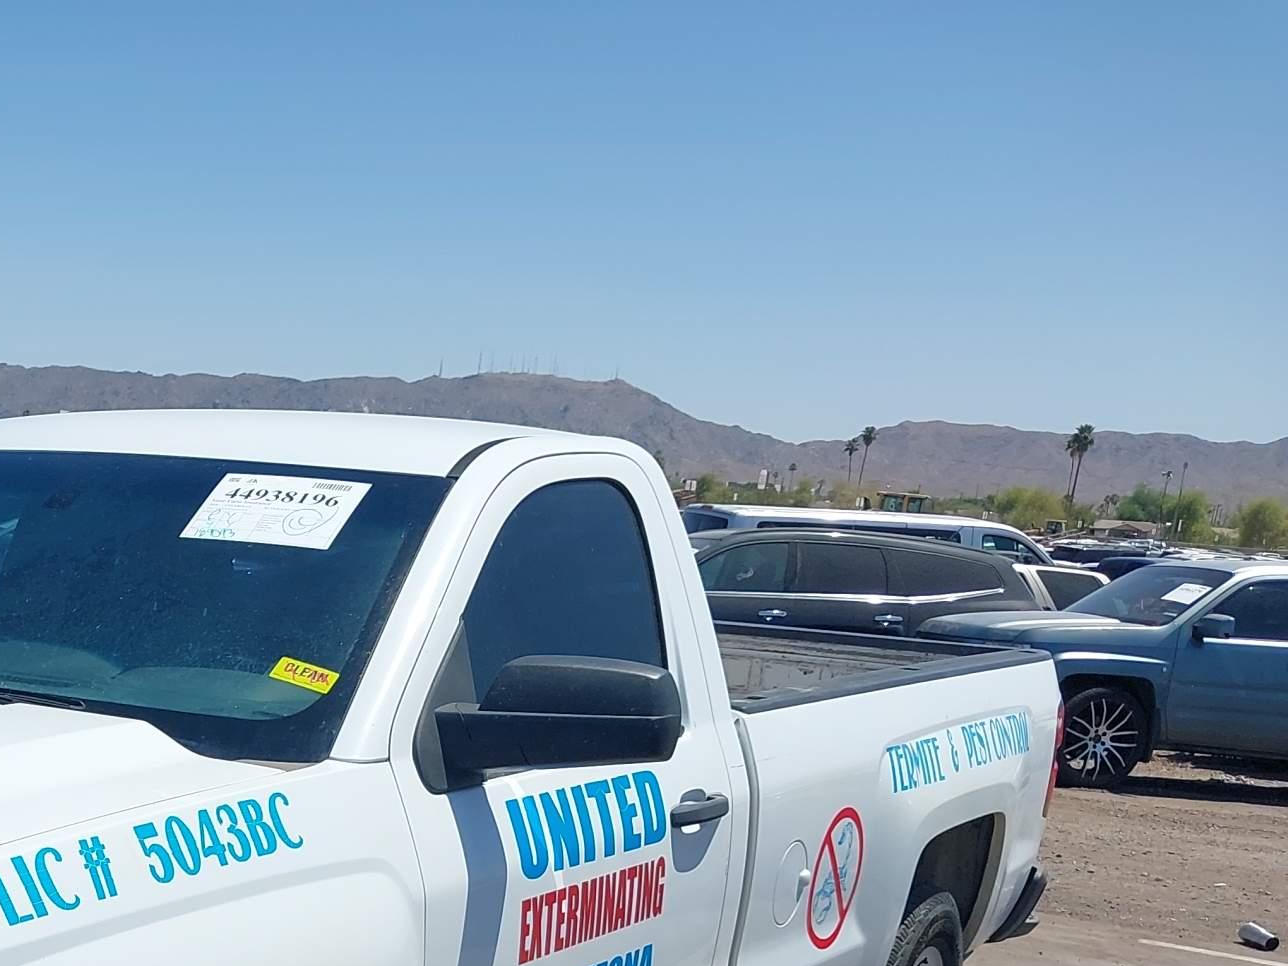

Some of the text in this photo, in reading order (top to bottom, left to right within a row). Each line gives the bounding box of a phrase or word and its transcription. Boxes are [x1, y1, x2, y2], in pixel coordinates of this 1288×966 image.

[224, 487, 340, 508] 44938196
[886, 711, 1030, 793] TERMITE & PEST CONTROL
[78, 835, 118, 901] #
[133, 792, 304, 884] 5043BC
[505, 769, 667, 879] UNITED
[518, 856, 666, 966] EXTERMINATING
